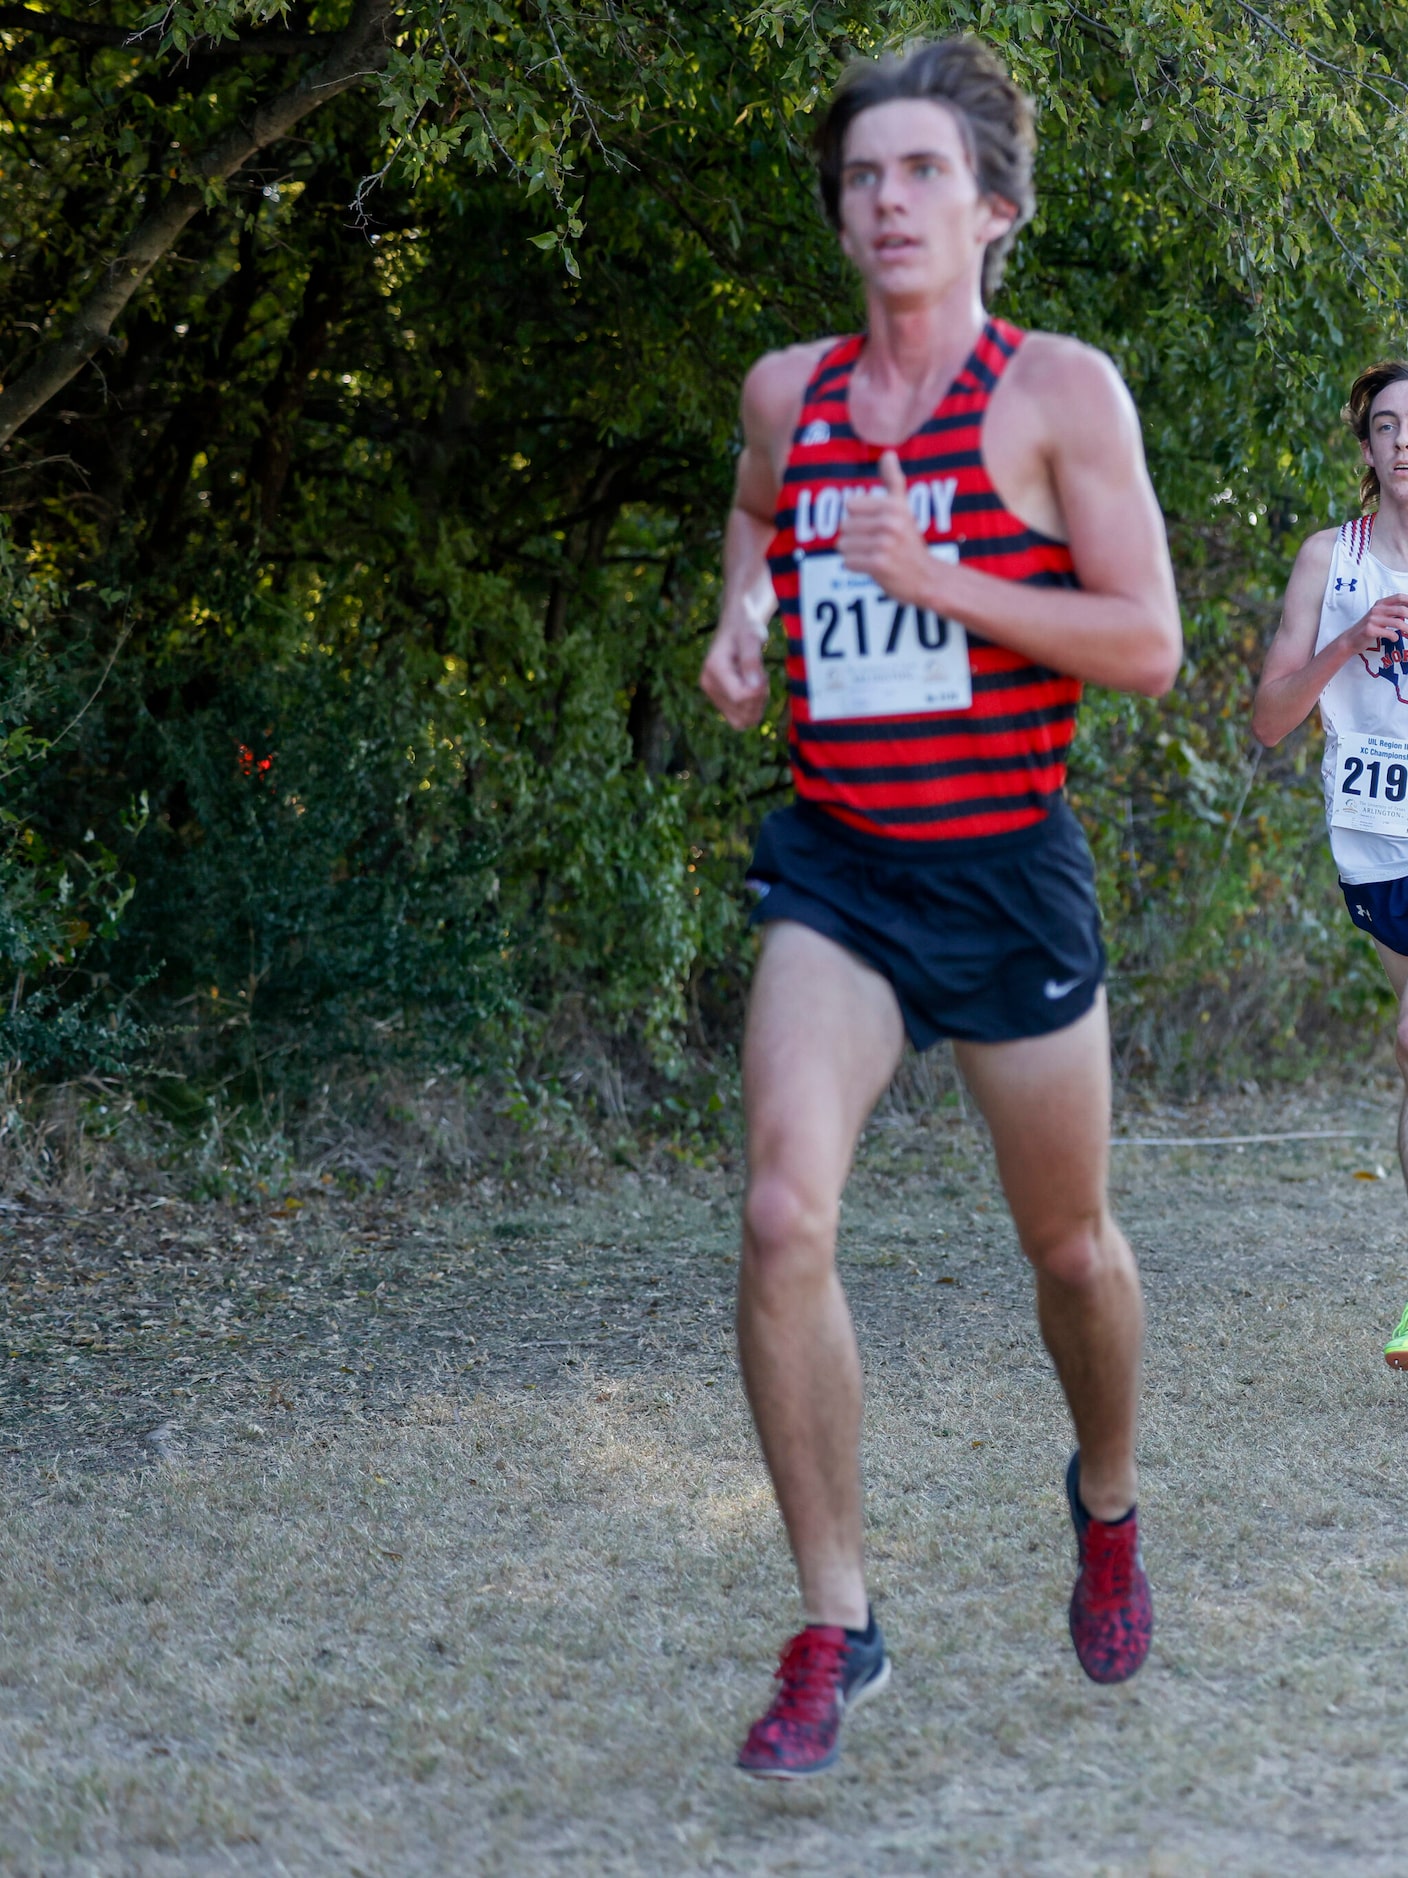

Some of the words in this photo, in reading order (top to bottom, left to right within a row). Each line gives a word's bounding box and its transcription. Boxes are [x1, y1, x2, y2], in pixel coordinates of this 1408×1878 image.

[795, 477, 958, 543] LOOY
[816, 597, 950, 660] 2170
[1368, 738, 1377, 746] UIL
[1379, 740, 1402, 750] Region
[1363, 808, 1401, 818] ARLINGTON
